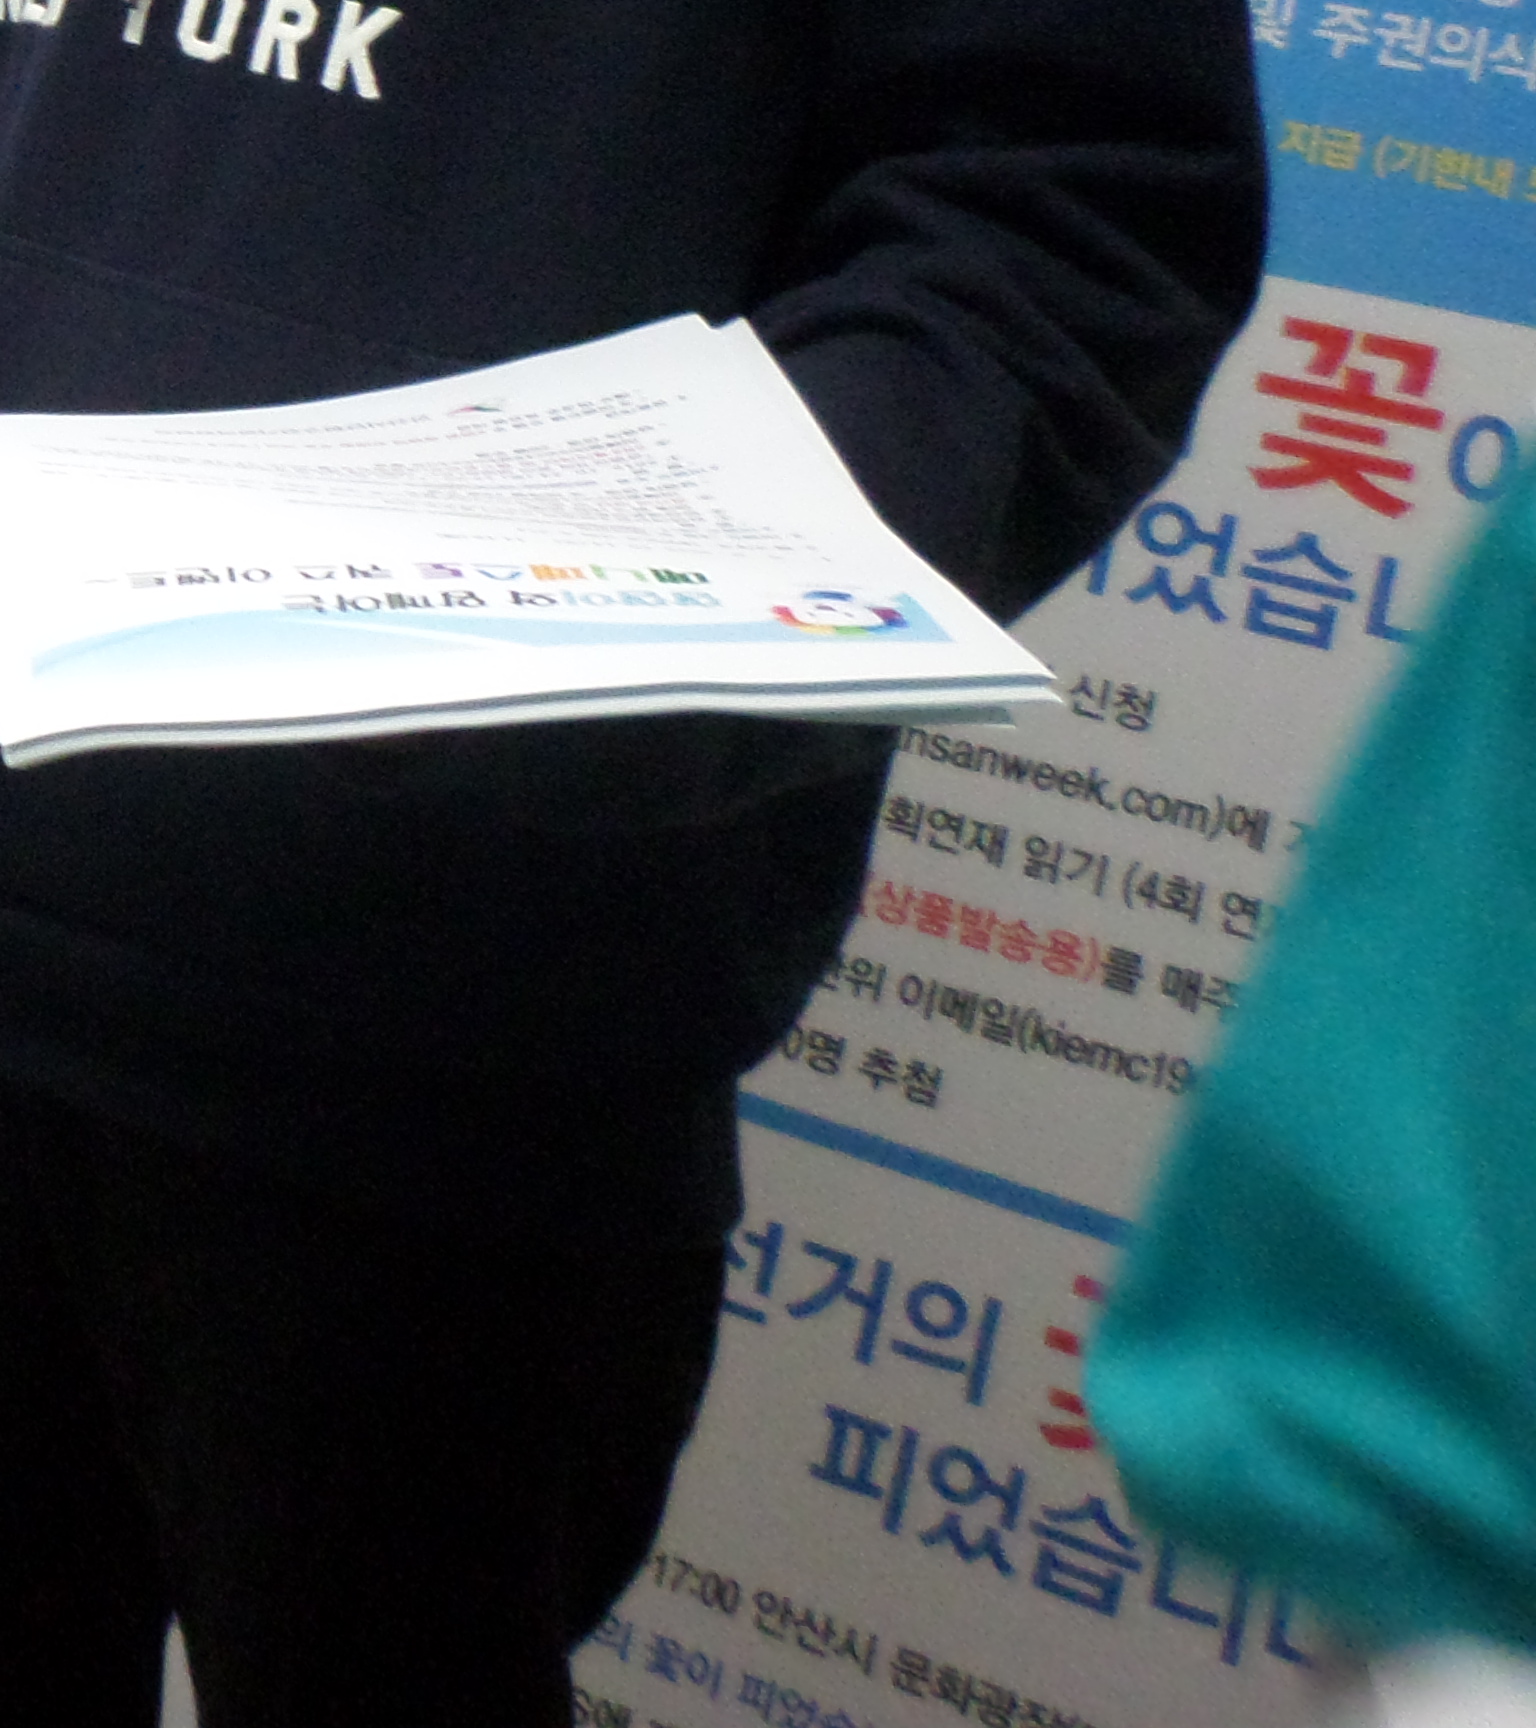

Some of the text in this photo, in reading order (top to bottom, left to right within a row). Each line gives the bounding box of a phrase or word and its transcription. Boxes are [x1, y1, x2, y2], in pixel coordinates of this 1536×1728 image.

[1279, 120, 1364, 171] 지급
[1068, 672, 1161, 735] 신청
[1023, 833, 1112, 898] 읽기
[857, 1045, 945, 1110] 추첨
[724, 1220, 1004, 1407] 선거의
[751, 1587, 881, 1677] 안산시
[889, 1644, 1096, 1728] 문화광
